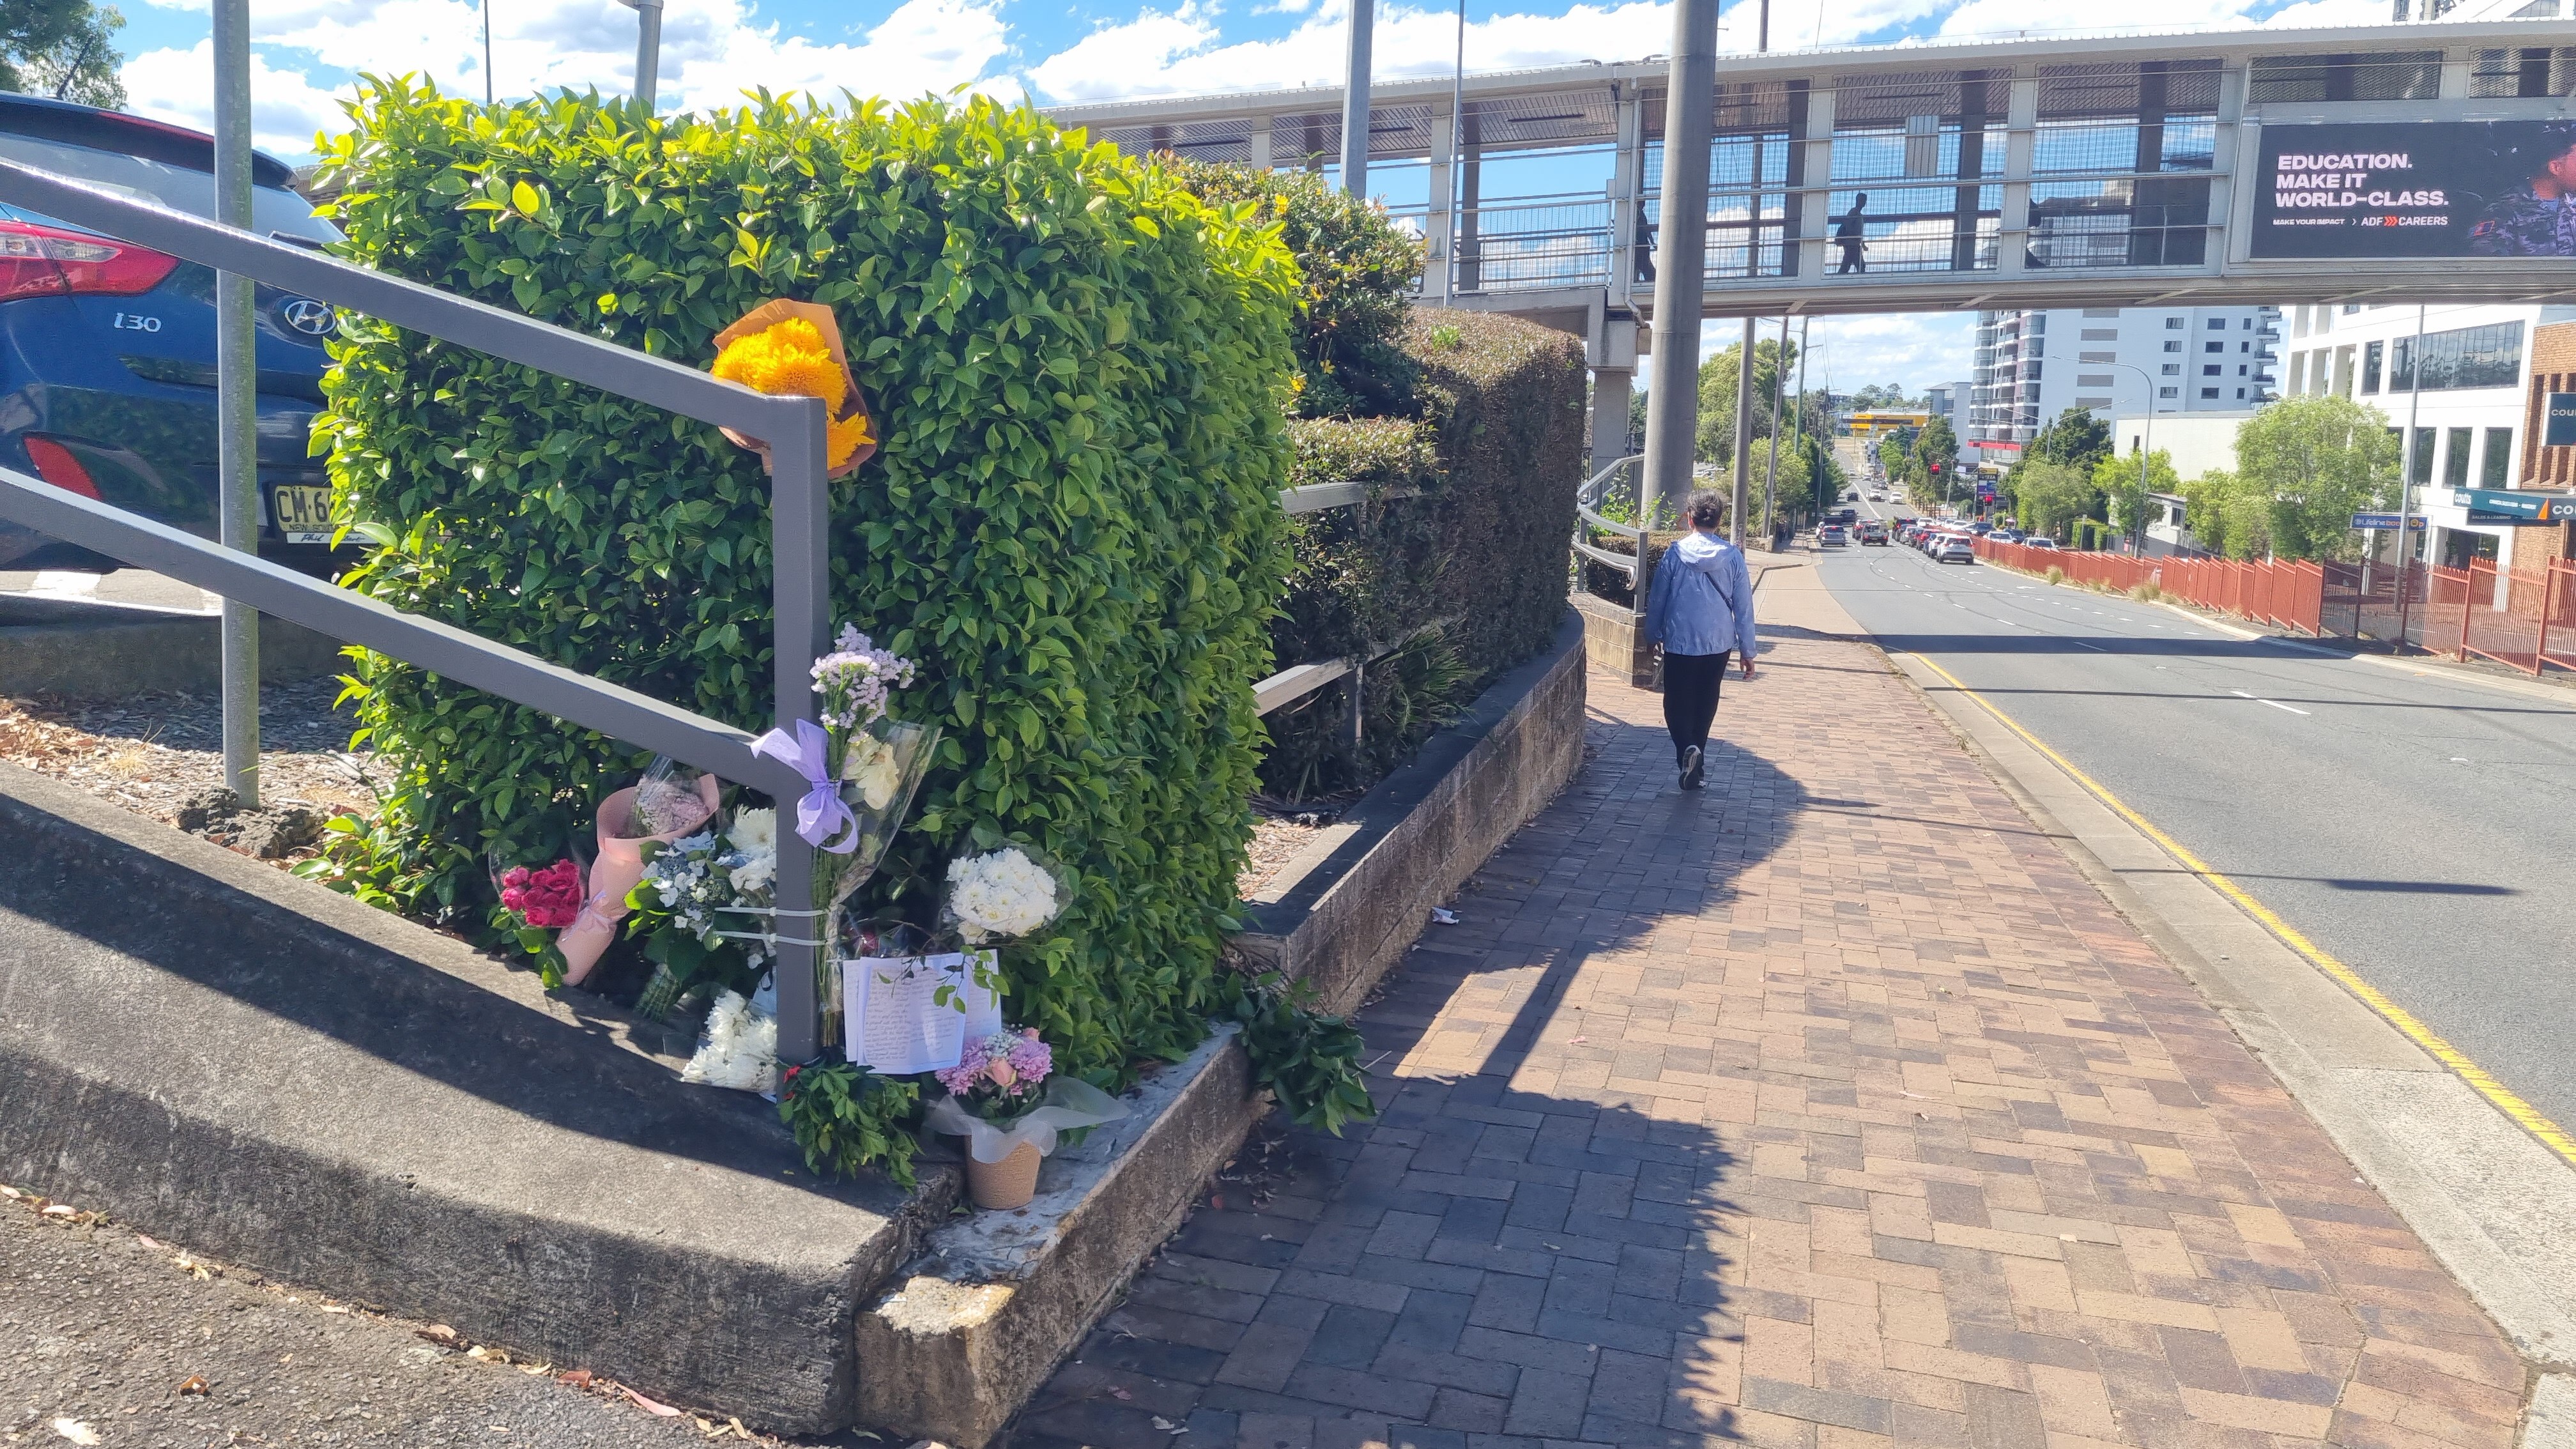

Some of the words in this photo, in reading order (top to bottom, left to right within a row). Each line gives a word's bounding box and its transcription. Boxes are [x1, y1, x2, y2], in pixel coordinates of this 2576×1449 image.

[2278, 153, 2412, 170] EDUCATION.
[2276, 174, 2341, 189] MAKE
[2345, 173, 2367, 188] IT
[2275, 190, 2450, 208] WORLD-CLASS.
[2361, 217, 2384, 227] ADF
[2398, 216, 2448, 226] CAREERS
[114, 312, 162, 332] i30
[2455, 493, 2472, 505] coutts
[2552, 504, 2576, 515] co
